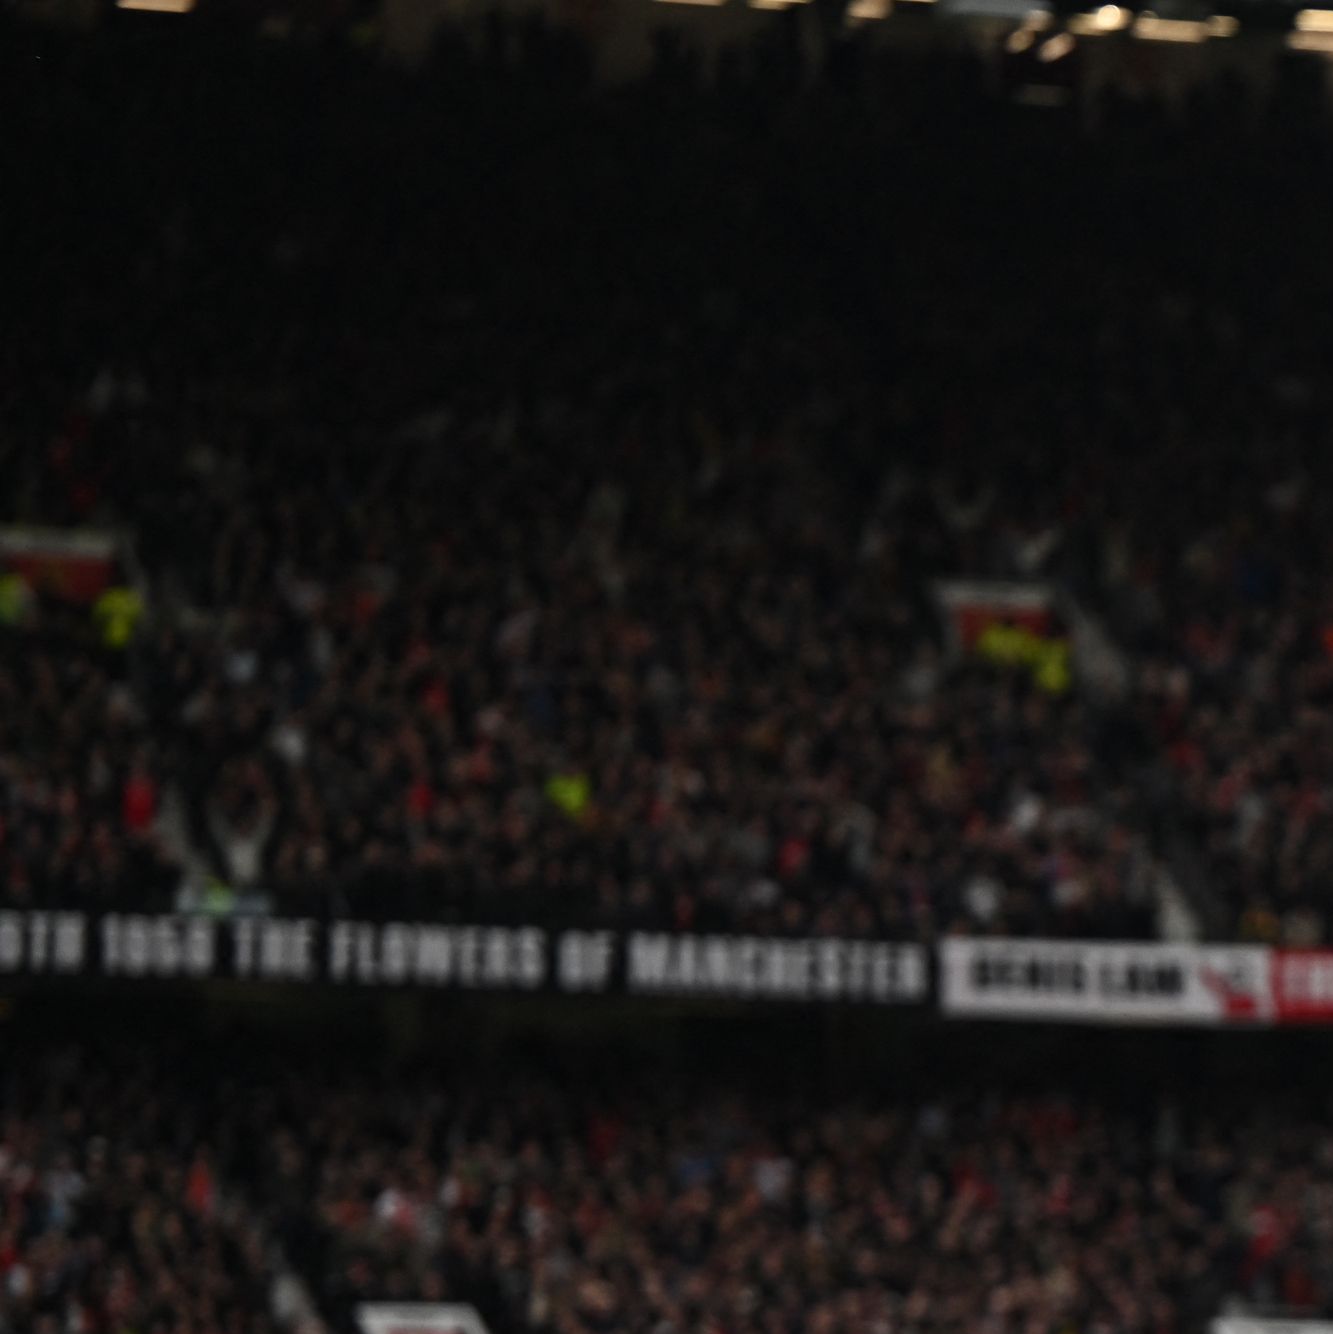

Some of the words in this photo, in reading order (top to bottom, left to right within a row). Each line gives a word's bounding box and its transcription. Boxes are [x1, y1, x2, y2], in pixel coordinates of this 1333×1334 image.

[330, 920, 546, 988] FLOWERS
[558, 929, 613, 993] OF
[627, 931, 927, 1002] MANCHESTER
